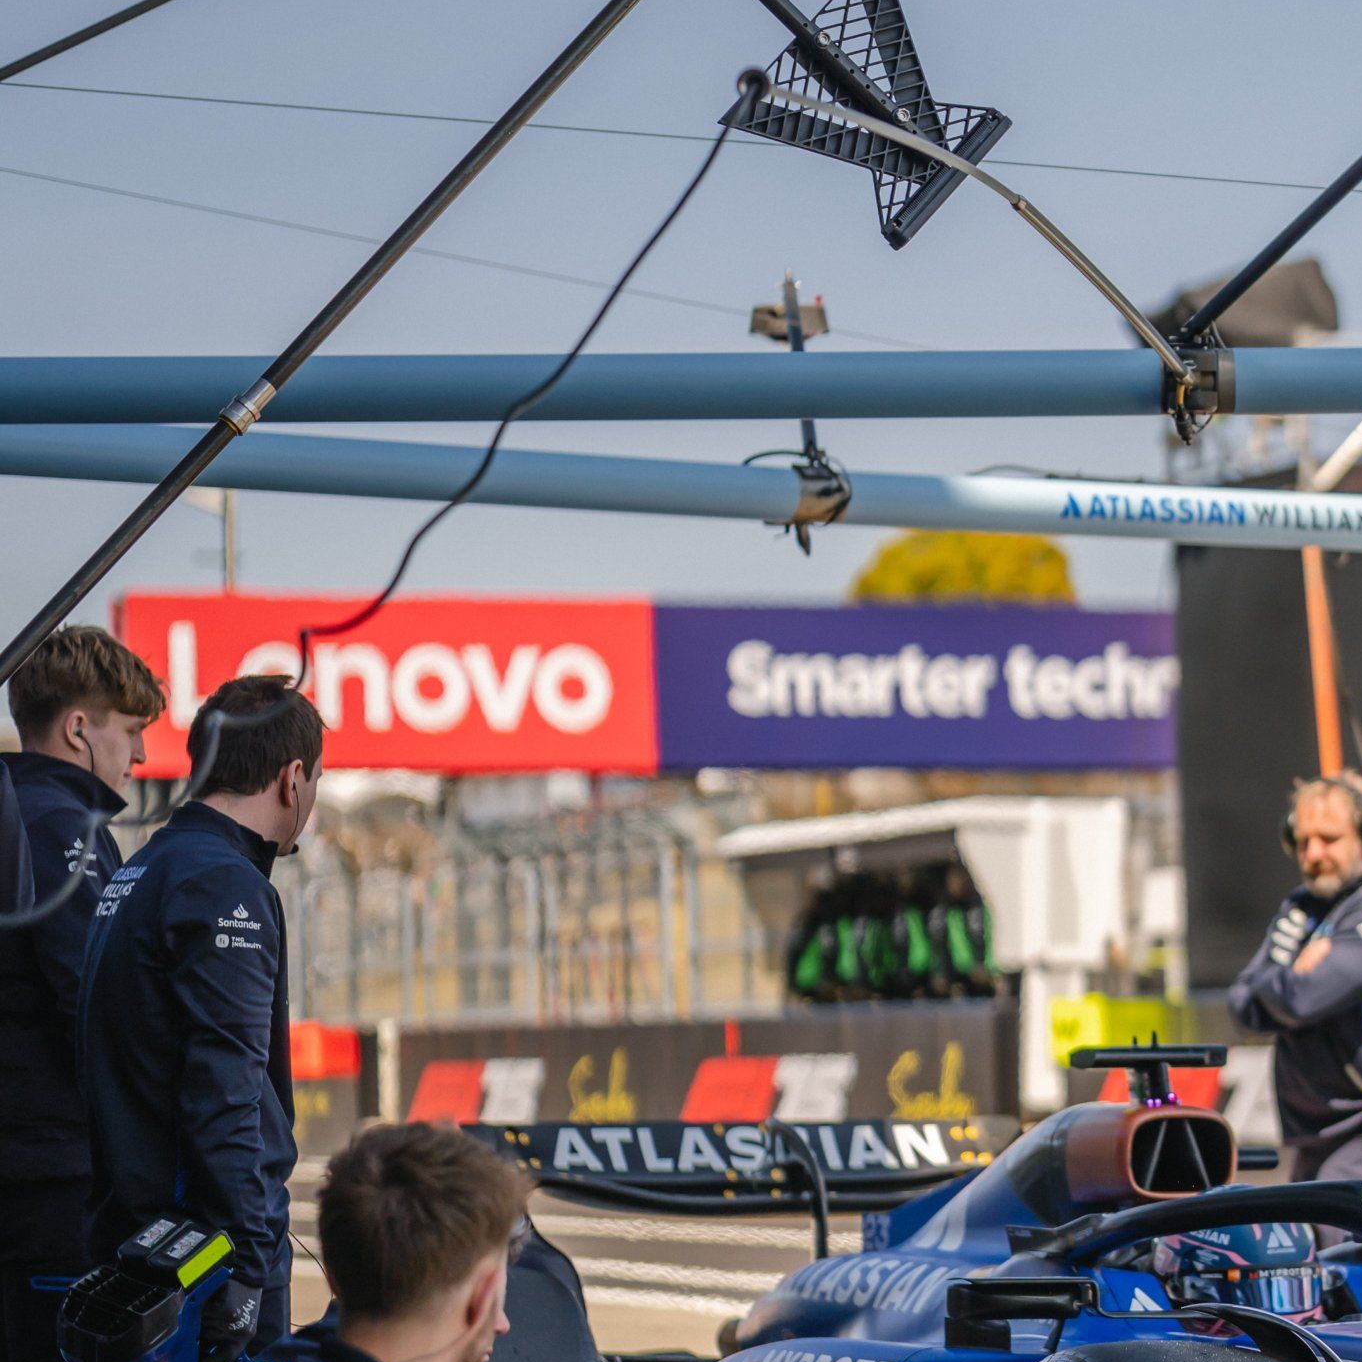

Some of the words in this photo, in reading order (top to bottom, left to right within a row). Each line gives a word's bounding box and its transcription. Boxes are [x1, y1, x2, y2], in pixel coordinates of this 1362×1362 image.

[1087, 493, 1246, 527] ATLASSIAN
[726, 639, 998, 719] Smarter
[218, 917, 262, 930] Santander
